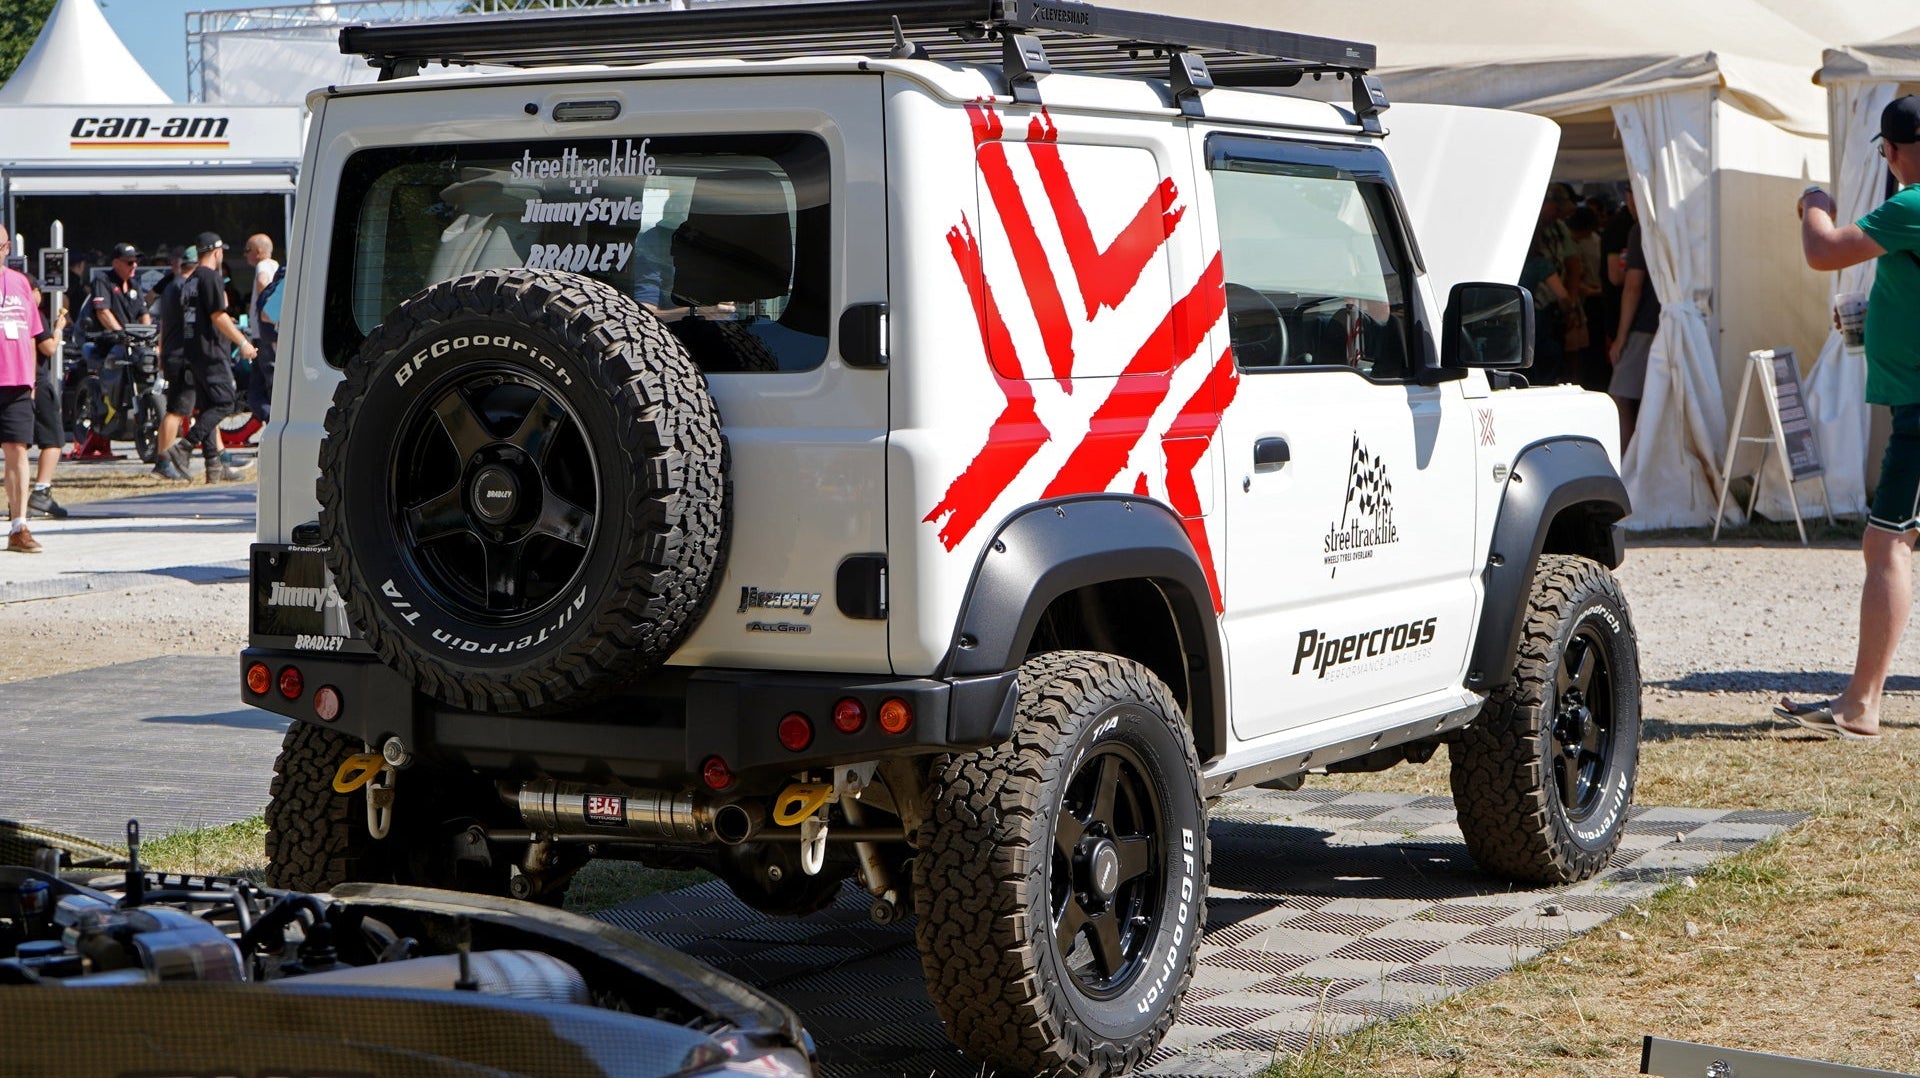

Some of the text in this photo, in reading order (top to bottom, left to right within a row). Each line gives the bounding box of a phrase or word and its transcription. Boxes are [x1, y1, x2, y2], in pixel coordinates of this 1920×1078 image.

[70, 117, 229, 138] can-am
[511, 138, 662, 180] streettracklife.
[521, 197, 643, 226] JimnyStyle
[524, 242, 633, 272] BRADLEY
[394, 335, 573, 387] BFGoodrich
[1324, 507, 1399, 553] streettracklife.
[1353, 550, 1373, 560] OVERLAND
[268, 581, 347, 612] JimnyS
[381, 579, 587, 653] All-Terrain T/A
[295, 634, 343, 651] BRADLEY
[1292, 617, 1437, 679] Pipercross
[1578, 771, 1627, 842] All-Terrain
[1137, 828, 1194, 1014] BFGoodrich
